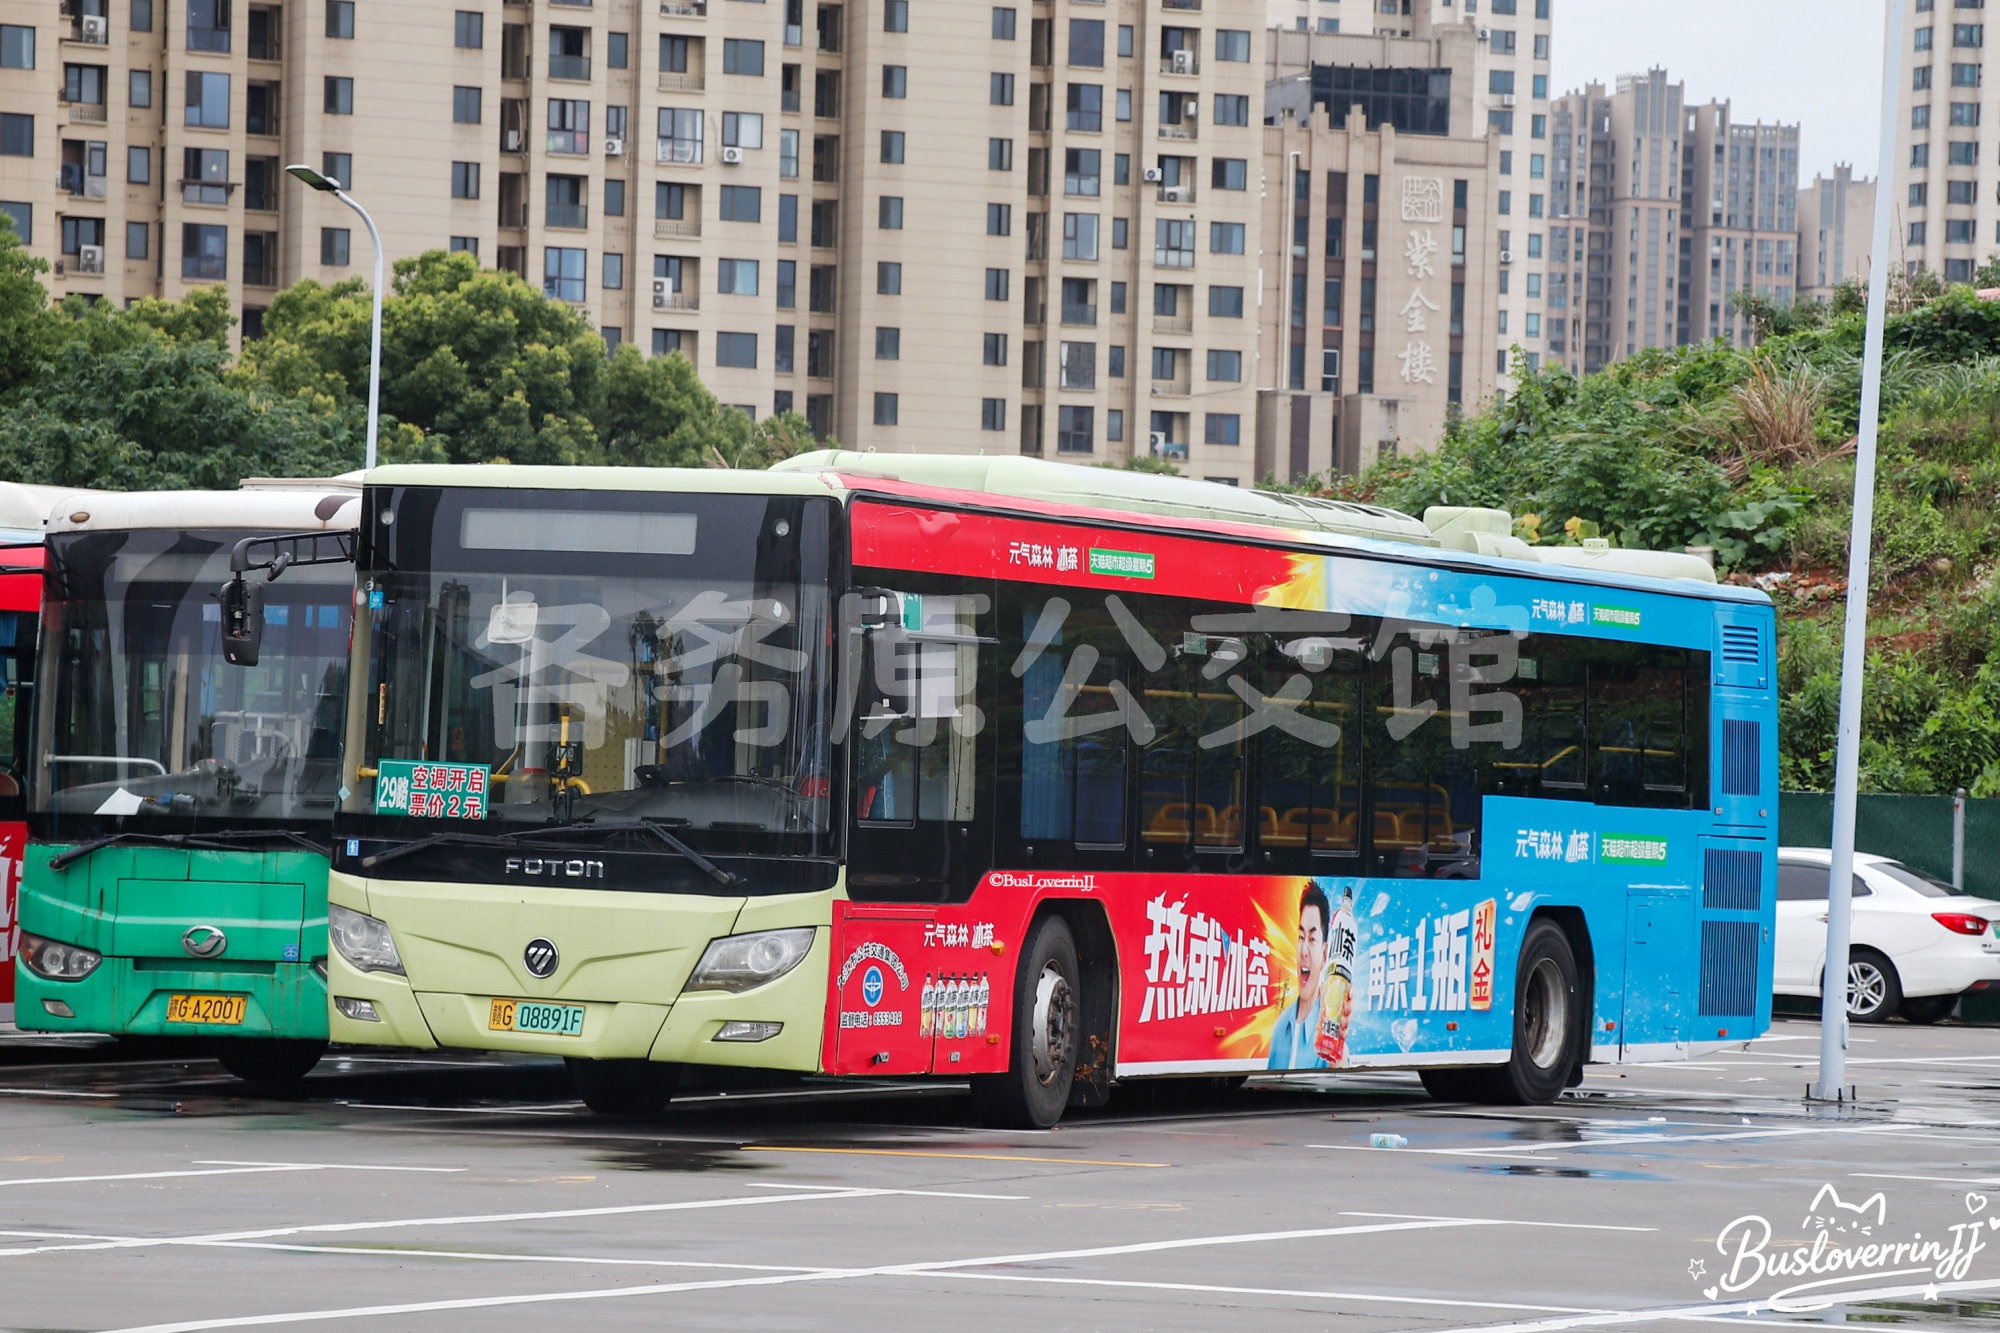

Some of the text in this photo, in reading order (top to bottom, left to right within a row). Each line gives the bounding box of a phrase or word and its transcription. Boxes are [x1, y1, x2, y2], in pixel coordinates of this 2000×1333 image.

[1009, 541, 1053, 569] 元气森林
[1056, 544, 1078, 571] 冰茶
[1532, 599, 1566, 622] 元气森林
[379, 776, 408, 810] 29路
[411, 766, 485, 794] 空调开启
[408, 792, 482, 819] 票价2元
[1516, 829, 1563, 860] 元气森林
[1565, 829, 1589, 862] 冰茶
[506, 859, 603, 878] FOTON
[924, 921, 994, 949] 元气森林 冰茶
[1139, 891, 1270, 1023] 热就冰茶
[1368, 908, 1468, 1011] 再来1瓶
[1473, 909, 1492, 1003] 礼金
